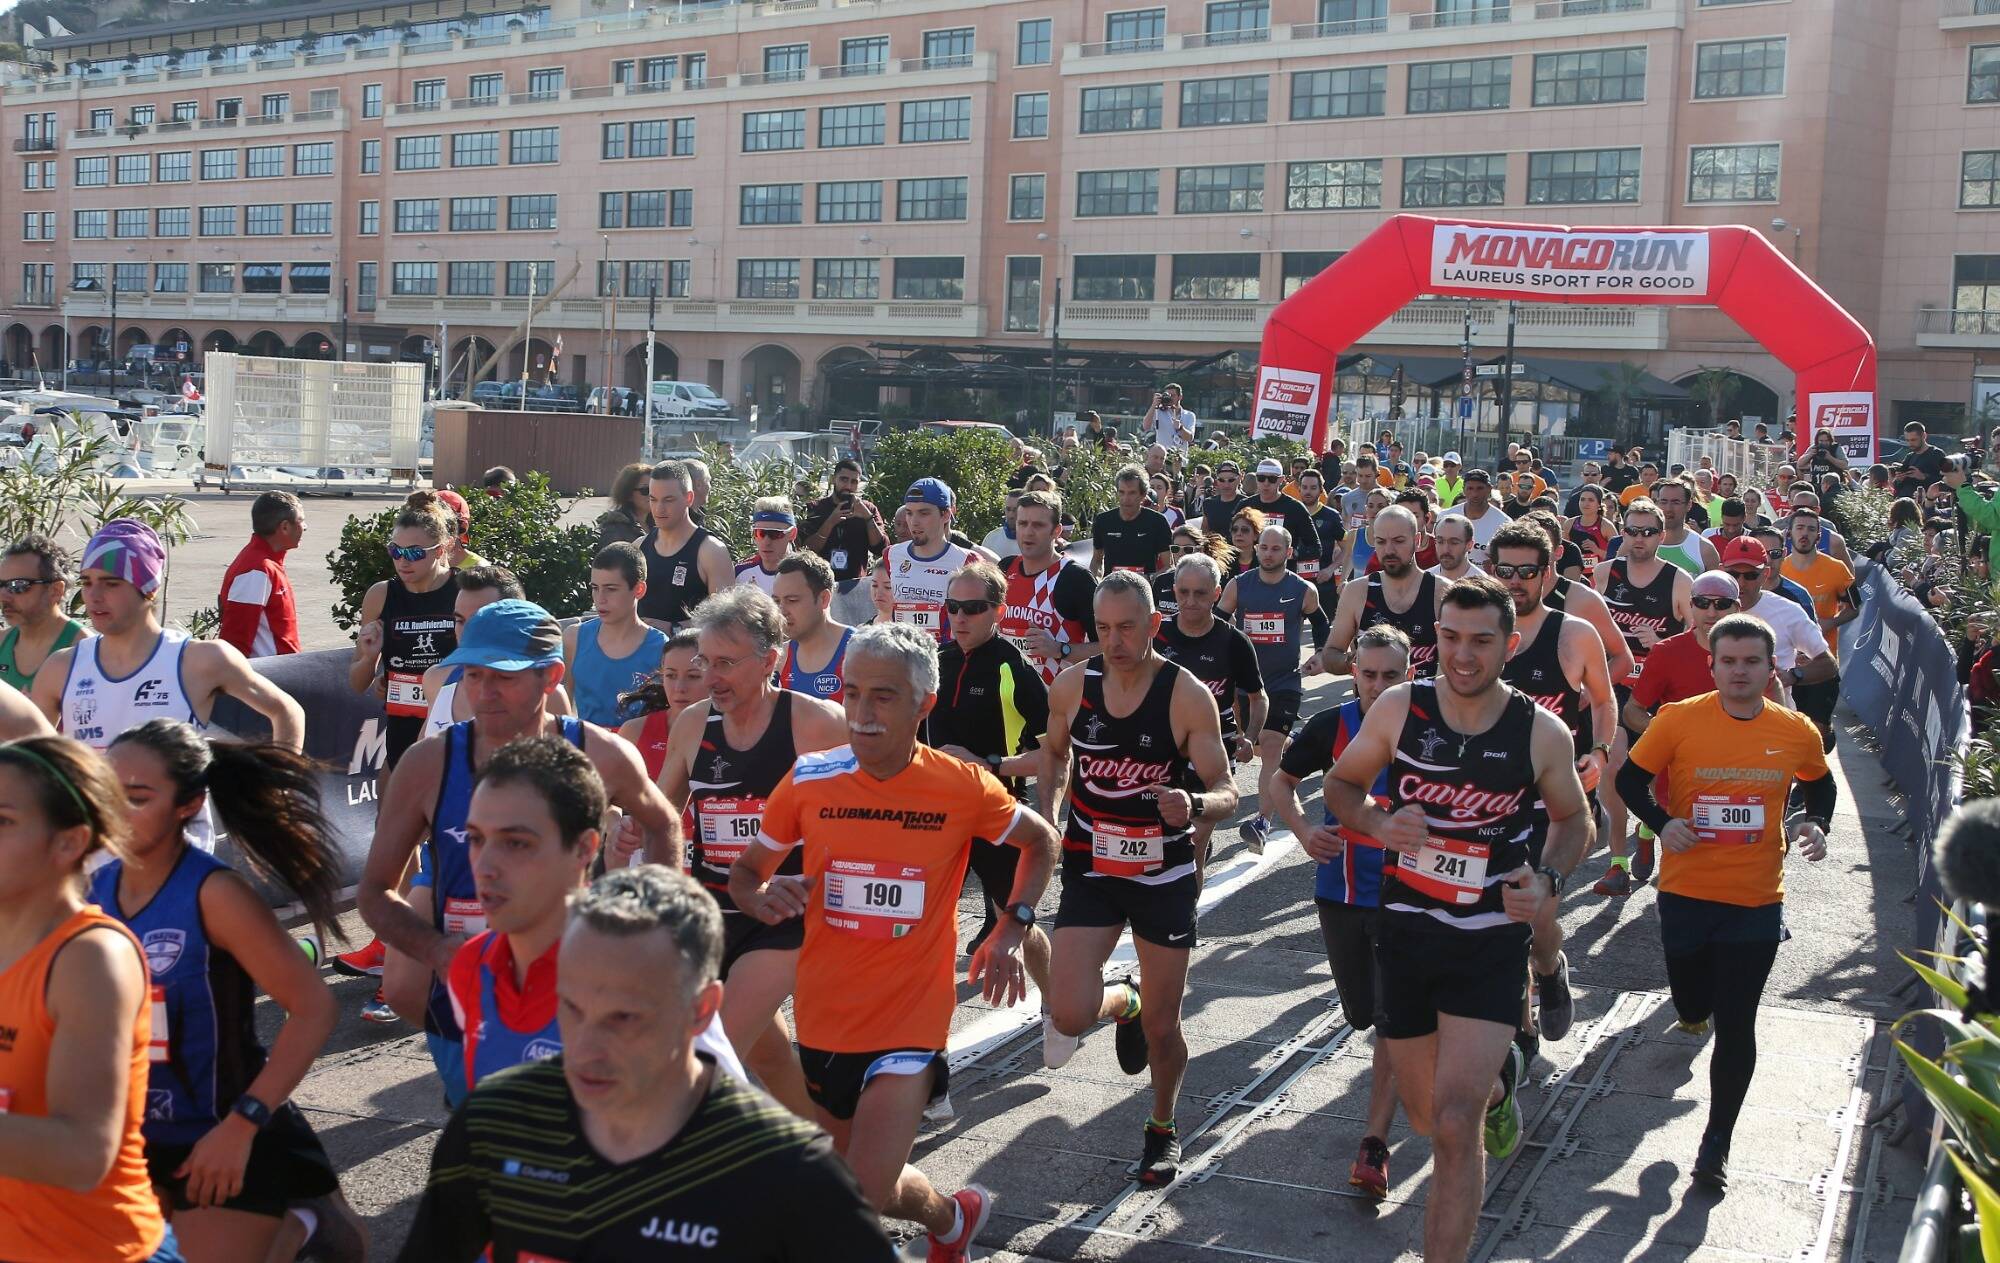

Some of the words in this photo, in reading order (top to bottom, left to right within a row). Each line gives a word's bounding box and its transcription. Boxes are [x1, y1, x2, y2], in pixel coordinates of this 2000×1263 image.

[1444, 232, 1695, 272] MONACORUN
[1443, 269, 1525, 285] LAUREUS
[1531, 273, 1590, 288] SPORT
[1596, 275, 1633, 288] FOR
[1639, 276, 1695, 289] GOOD
[1594, 440, 1605, 453] P
[913, 613, 929, 625] 197
[1005, 605, 1053, 628] MONACO
[1259, 621, 1275, 631] 149
[1079, 755, 1174, 788] Cavigal
[1141, 792, 1159, 800] NIC
[1399, 774, 1527, 818] Cavigal
[819, 807, 948, 828] CLUBMARATHON
[1721, 808, 1751, 824] 300
[730, 817, 761, 838] 150
[1120, 839, 1148, 856] 242
[1433, 854, 1467, 878] 241
[863, 882, 902, 908] 190
[843, 919, 860, 930] PINO
[640, 1217, 720, 1248] J.LUC
